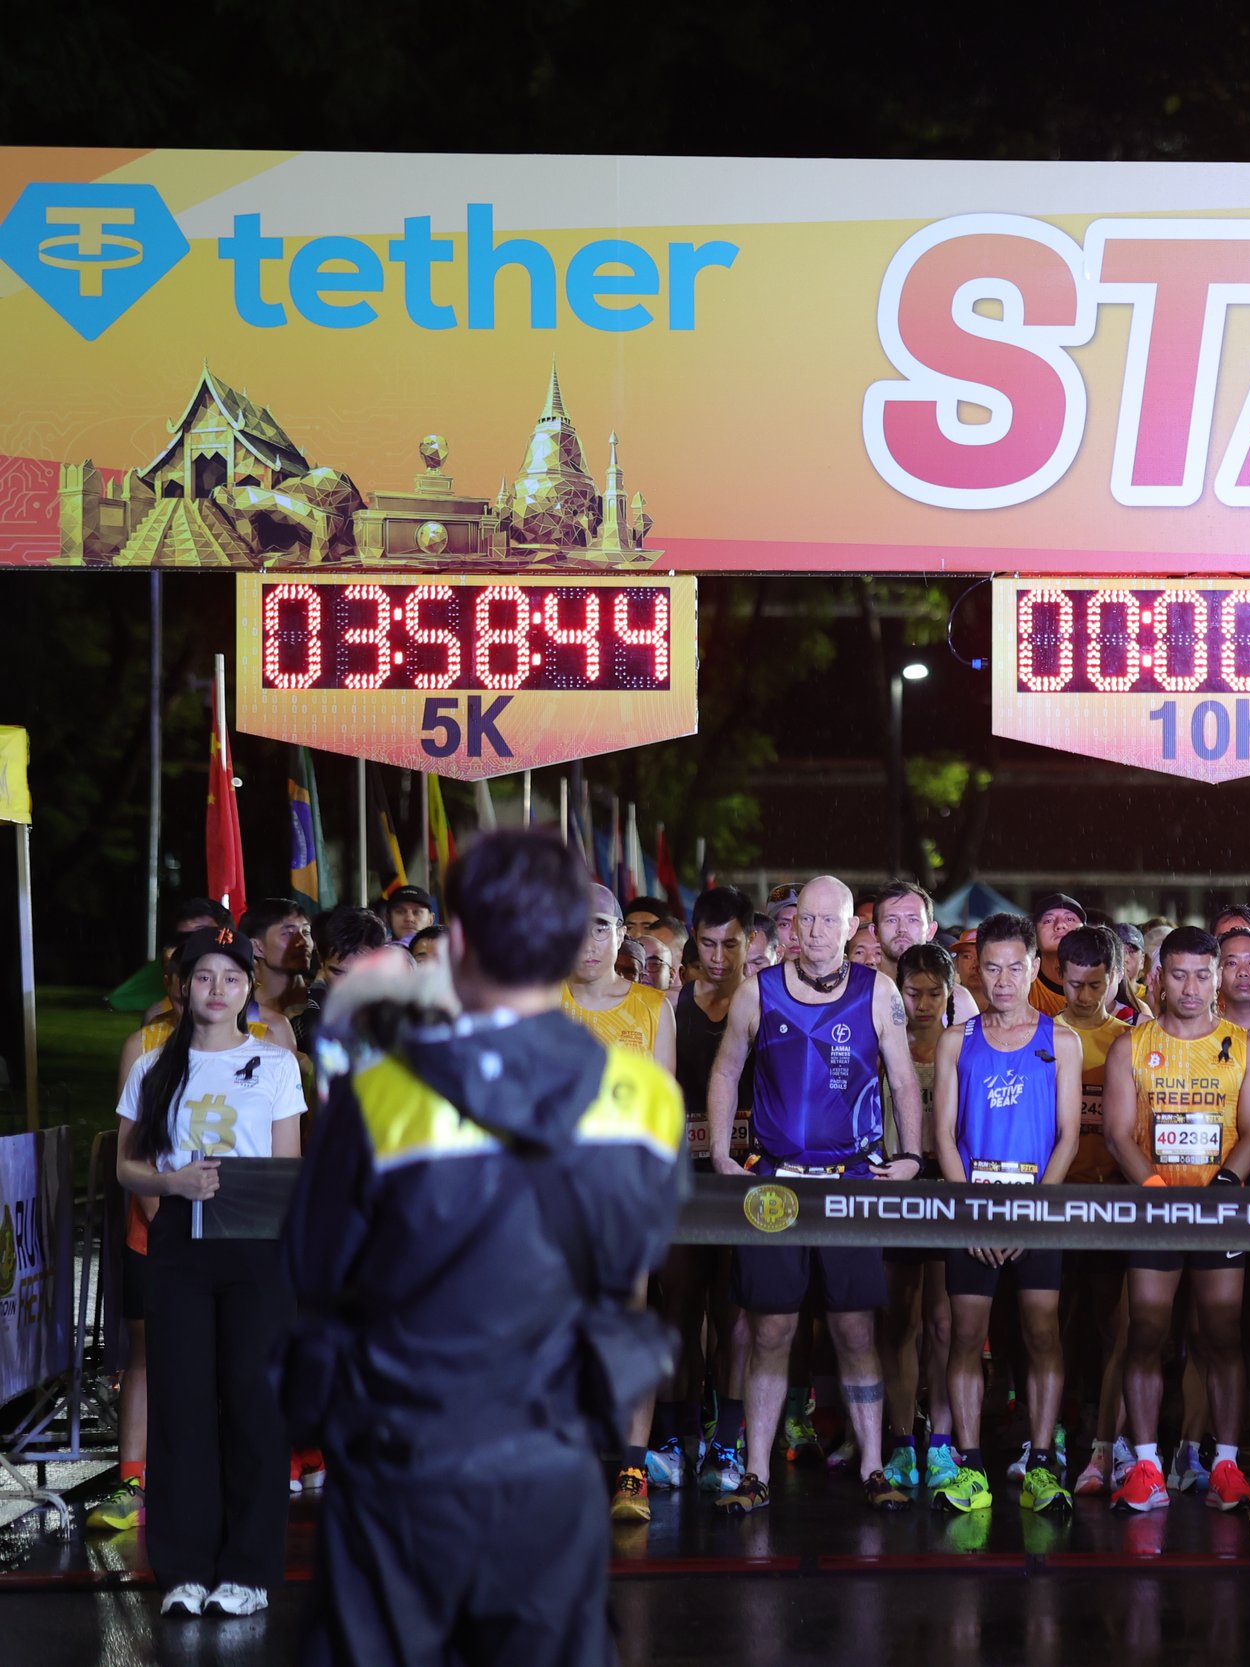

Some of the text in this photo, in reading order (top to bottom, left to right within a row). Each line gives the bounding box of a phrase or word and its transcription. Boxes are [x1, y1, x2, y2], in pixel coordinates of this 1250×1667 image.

[218, 203, 740, 332] tether
[265, 584, 668, 690] 03:58:44
[420, 695, 515, 758] 5K
[987, 1083, 1024, 1100] ACTIVE
[1155, 1077, 1220, 1089] RUN FOR
[990, 1095, 1019, 1109] PEAK
[1147, 1092, 1227, 1106] FREEDOM
[825, 1194, 956, 1220] BITCOIN
[965, 1198, 1137, 1224] THAILAND
[1145, 1201, 1240, 1226] HALF
